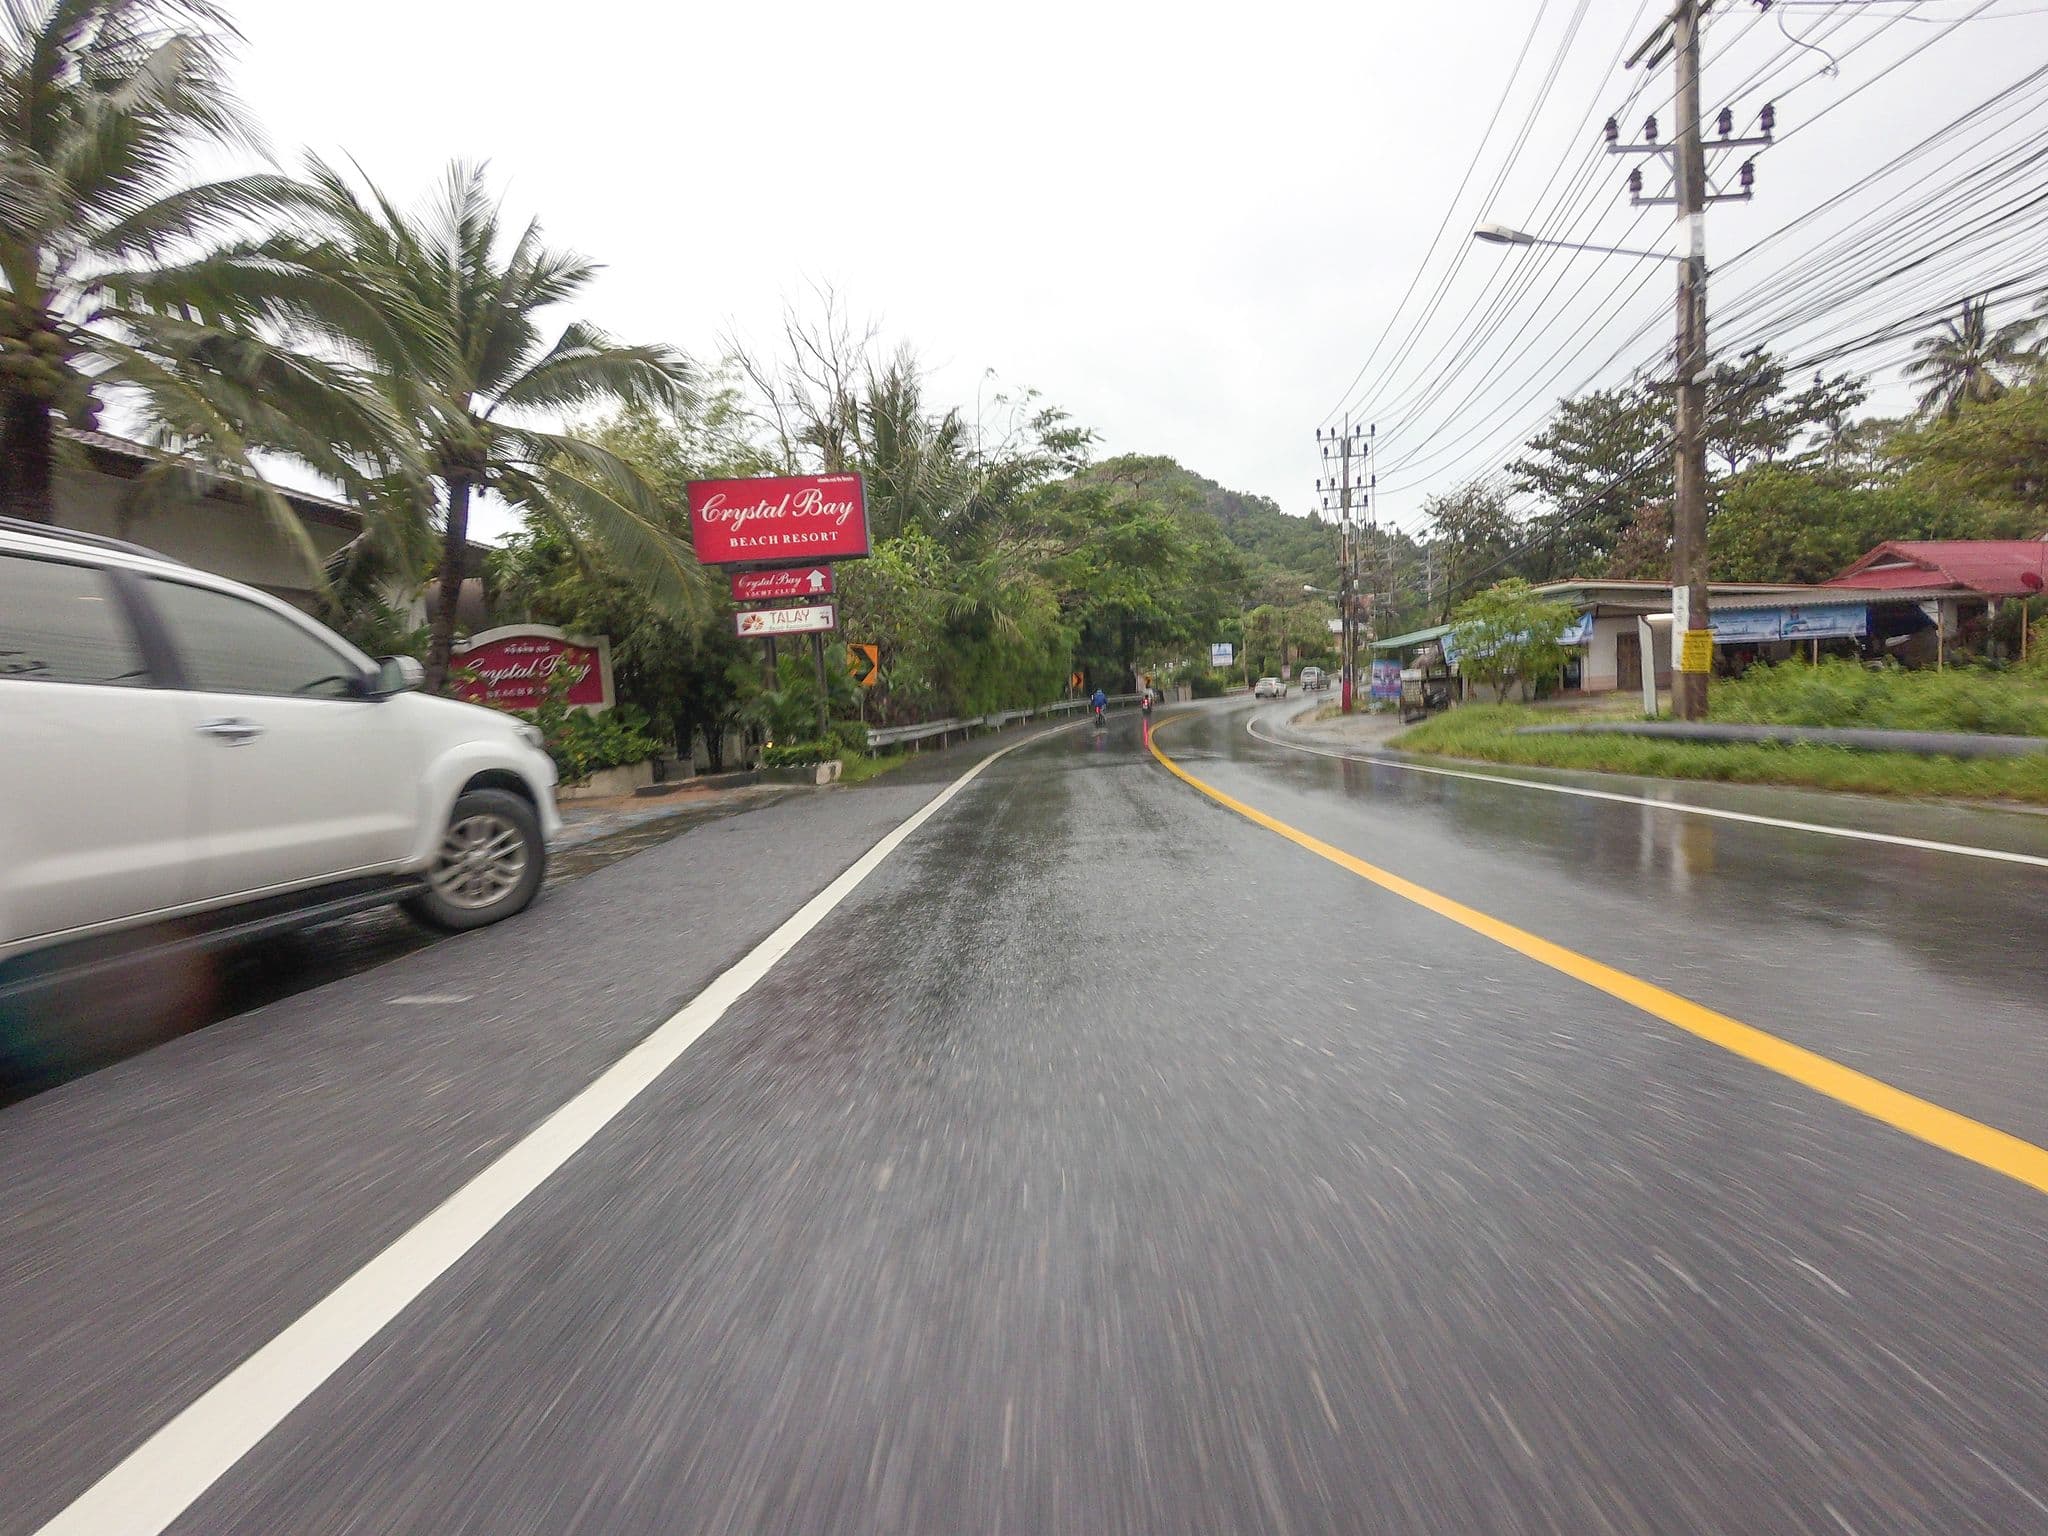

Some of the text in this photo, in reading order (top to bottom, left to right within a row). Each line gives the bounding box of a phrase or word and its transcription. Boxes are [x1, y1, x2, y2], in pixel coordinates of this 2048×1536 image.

[698, 488, 854, 532] Crystal Bay
[729, 531, 839, 548] BEACH RESORT
[738, 571, 802, 591] Crystal Bay
[769, 608, 810, 624] TALAY
